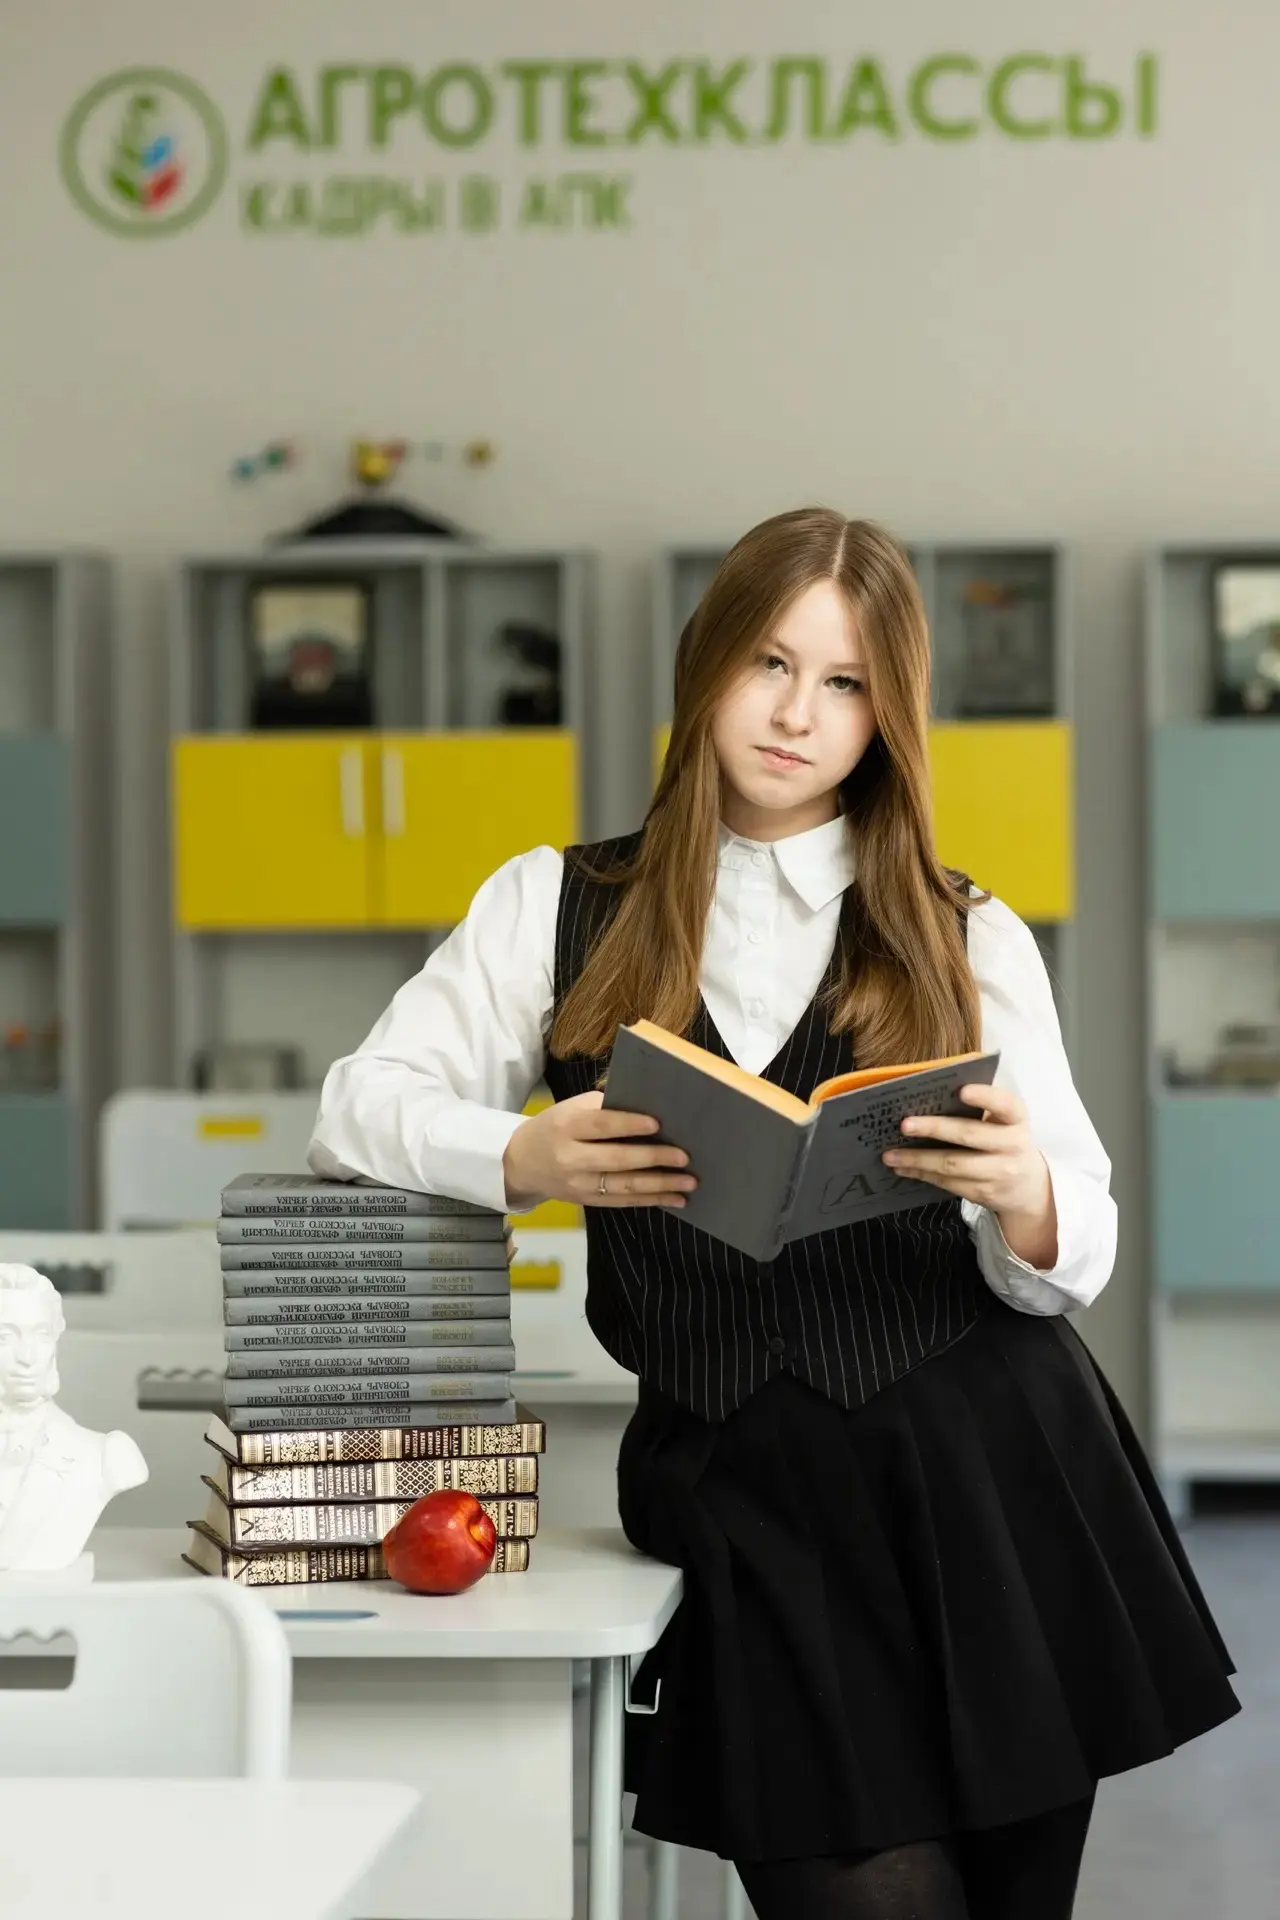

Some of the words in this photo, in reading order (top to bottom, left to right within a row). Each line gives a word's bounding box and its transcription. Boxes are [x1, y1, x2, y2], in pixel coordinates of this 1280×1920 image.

[246, 52, 1159, 152] АГРОТЕХКЛАССЫ
[243, 177, 443, 236] КАДРЫ
[460, 176, 498, 232] В
[522, 173, 633, 231] АПК
[276, 1196, 307, 1204] ЯЗЫКА
[312, 1196, 359, 1204] РУССКОГО
[364, 1196, 406, 1205] СЛОВАРЬ
[245, 1205, 342, 1214] ФРАЗЕОЛОГИЧЕСКИЙ
[349, 1205, 406, 1214] ШКОЛЬНЫЙ
[274, 1220, 304, 1228] ЯЗЫКА
[309, 1221, 356, 1230] РУССКОГО
[362, 1222, 404, 1231] СЛОВАРЬ
[242, 1228, 339, 1238] ФРАЗЕОЛОГИЧЕСКИЙ
[346, 1231, 403, 1240] ШКОЛЬНЫЙ
[308, 1251, 354, 1260] РУССКОГО
[360, 1250, 402, 1259] СЛОВАРЬ
[240, 1260, 338, 1270] ФРАЗЕОЛОГИЧЕСКИЙ
[345, 1260, 402, 1268] ШКОЛЬНЫЙ
[275, 1276, 306, 1284] ЯЗЫКА
[311, 1276, 357, 1284] РУССКОГО
[364, 1275, 406, 1284] СЛОВАРЬ
[243, 1285, 341, 1296] ФРАЗЕОЛОГИЧЕСКИЙ
[348, 1285, 406, 1293] ШКОЛЬНЫЙ
[278, 1304, 310, 1313] ЯЗЫКА
[314, 1303, 361, 1312] РУССКОГО
[367, 1301, 409, 1311] СЛОВАРЬ
[247, 1312, 345, 1323] ФРАЗЕОЛОГИЧЕСКИЙ
[352, 1311, 410, 1321] ШКОЛЬНЫЙ
[276, 1327, 307, 1335] ЯЗЫКА
[311, 1326, 358, 1335] РУССКОГО
[364, 1325, 406, 1334] СЛОВАРЬ
[243, 1336, 341, 1346] ФРАЗЕОЛОГИЧЕСКИЙ
[348, 1335, 406, 1344] ШКОЛЬНЫЙ
[279, 1359, 309, 1367] ЯЗЫКА
[315, 1358, 362, 1367] РУССКОГО
[368, 1357, 409, 1366] СЛОВАРЬ
[247, 1367, 345, 1377] ФРАЗЕОЛОГИЧЕСКИЙ
[352, 1367, 409, 1375] ШКОЛЬНЫЙ
[278, 1385, 310, 1394] ЯЗЫКА
[314, 1383, 361, 1392] РУССКОГО
[367, 1381, 409, 1390] СЛОВАРЬ
[246, 1393, 345, 1404] ФРАЗЕОЛОГИЧЕСКИЙ
[352, 1390, 409, 1401] ШКОЛЬНЫЙ
[281, 1408, 311, 1417] ЯЗЫКА
[316, 1407, 362, 1416] РУССКОГО
[369, 1406, 410, 1415] СЛОВАРЬ
[249, 1417, 346, 1428] ФРАЗЕОЛОГИЧЕСКИЙ
[354, 1415, 410, 1425] ШКОЛЬНЫЙ
